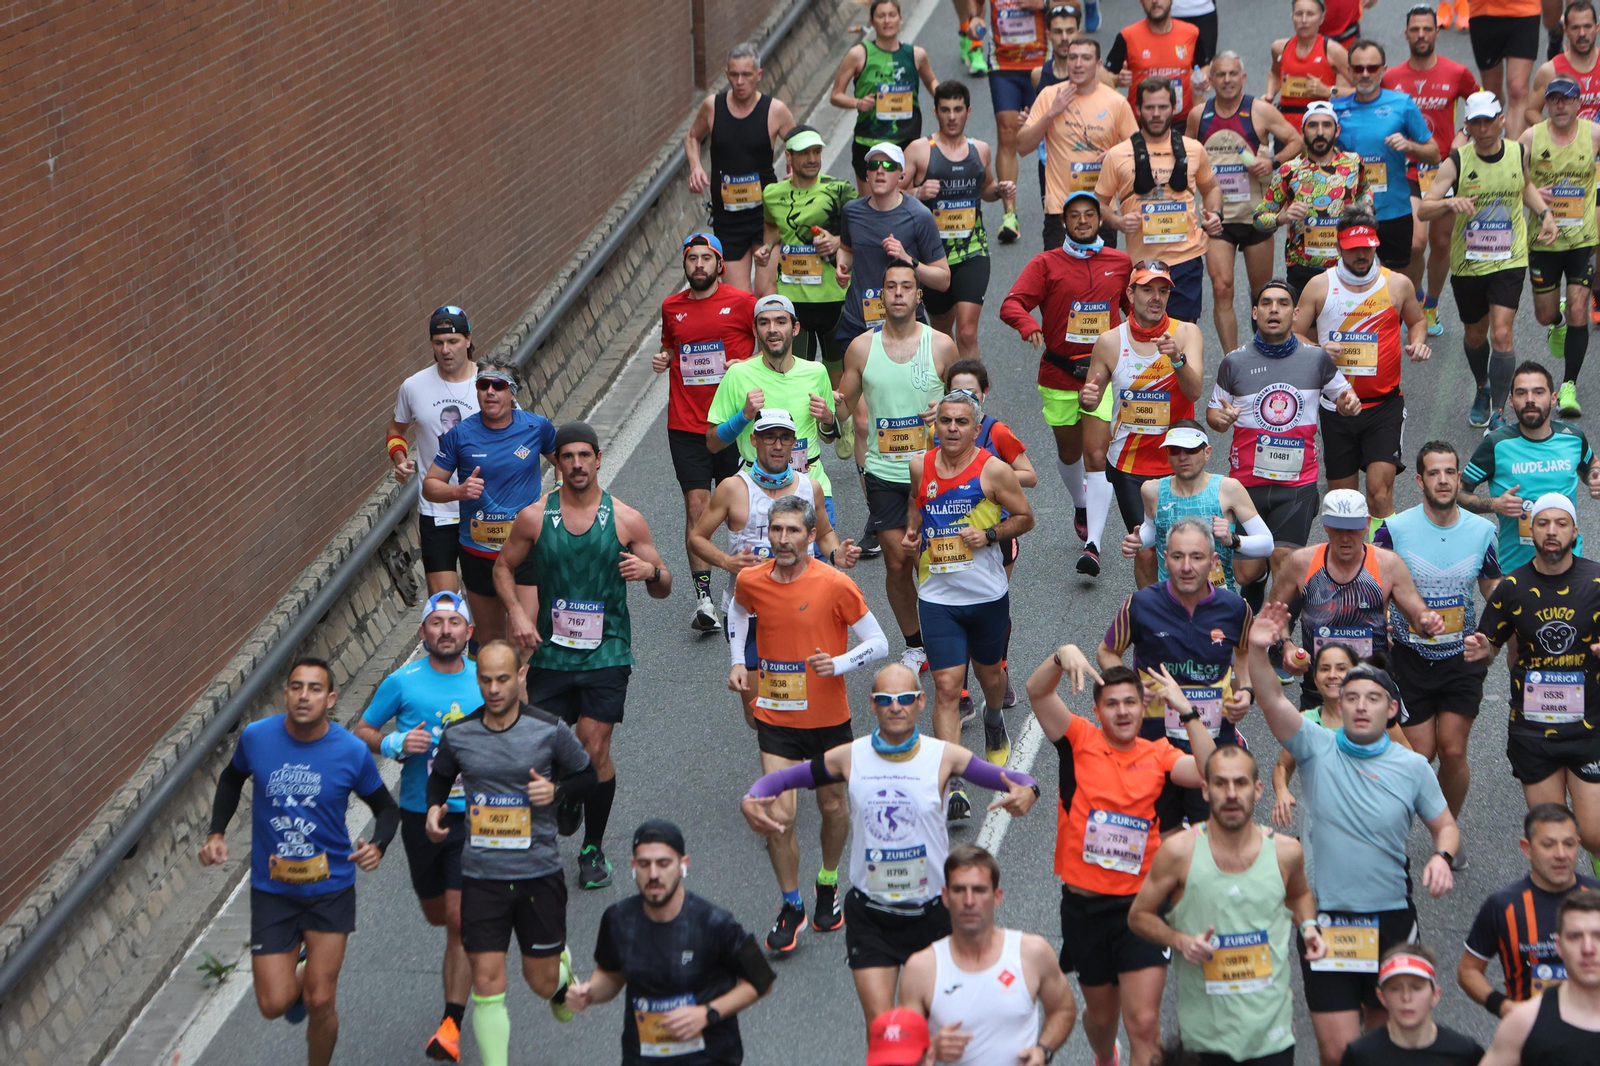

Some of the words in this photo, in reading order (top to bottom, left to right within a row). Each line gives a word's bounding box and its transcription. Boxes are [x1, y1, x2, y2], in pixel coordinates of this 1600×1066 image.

[1363, 298, 1376, 307] life
[1152, 362, 1164, 370] life
[442, 399, 473, 410] FELICIDAD
[1269, 452, 1289, 460] 10481
[1512, 459, 1572, 474] MUDEJARS
[926, 504, 972, 514] PALACIEGO
[938, 543, 954, 551] 6115
[944, 554, 966, 562] CARLOS
[569, 602, 598, 610] ZURICH
[1428, 598, 1458, 606] ZURICH
[1535, 606, 1575, 622] TENGO
[568, 618, 585, 626] 7167
[1163, 659, 1220, 675] PRIVILEGE
[1545, 674, 1578, 682] ZURICH
[770, 679, 787, 687] 5538
[1544, 691, 1564, 699] 6535
[1111, 815, 1143, 828] ZURICH
[1107, 832, 1128, 844] 7878
[886, 848, 921, 860] ZURICH
[1335, 917, 1371, 926] ZURICH
[1224, 935, 1261, 946] ZURICH
[651, 997, 688, 1011] ZURICH
